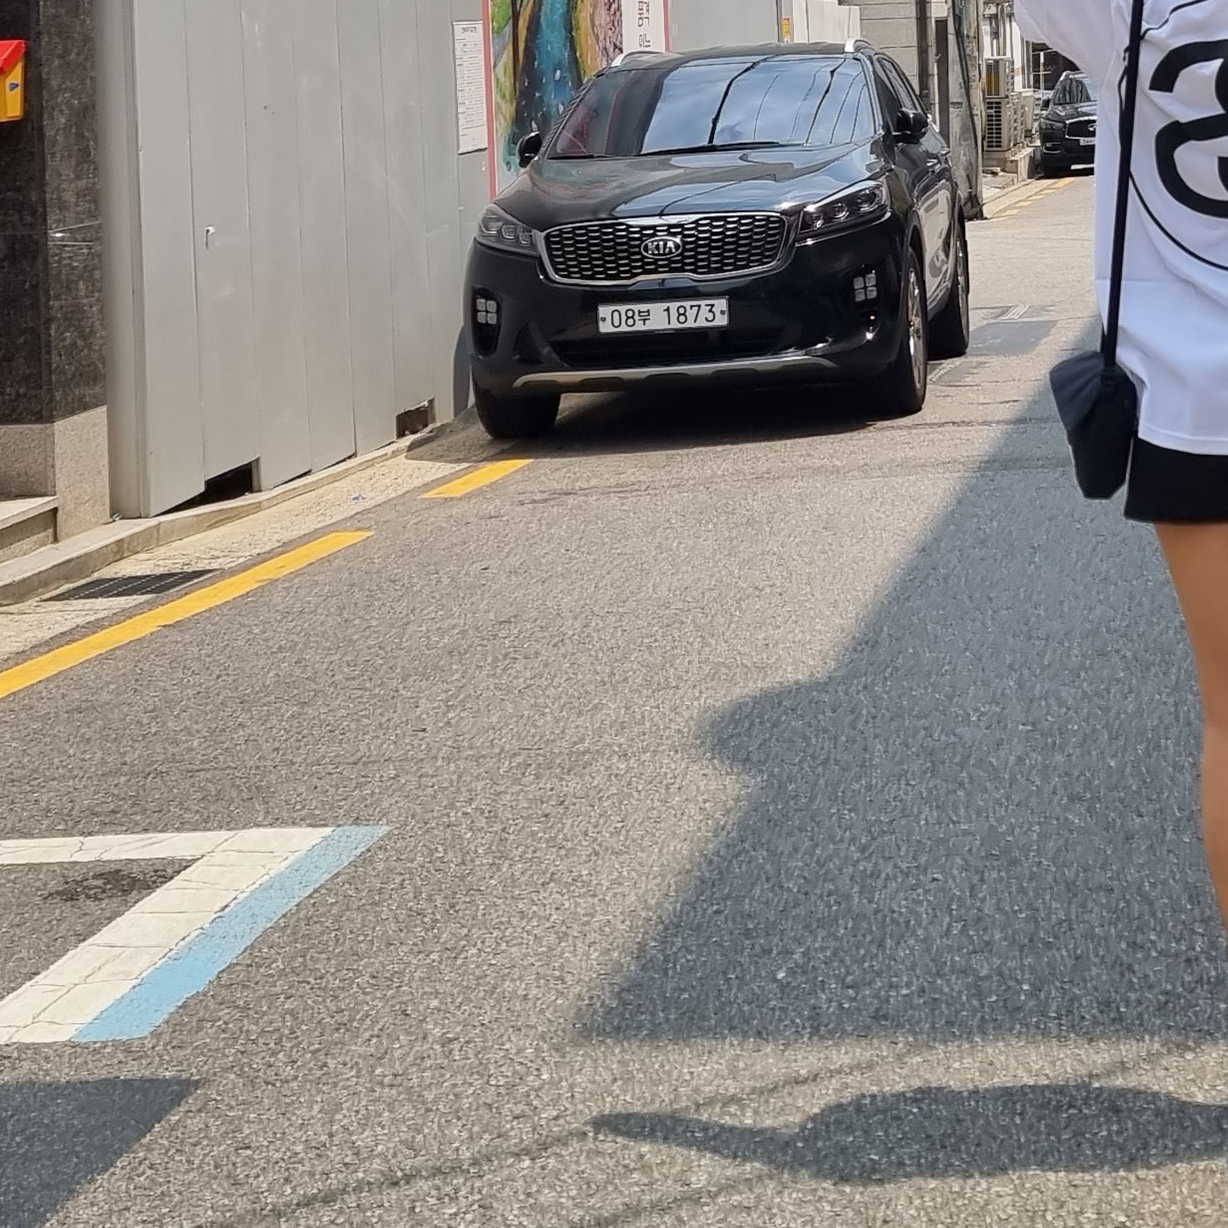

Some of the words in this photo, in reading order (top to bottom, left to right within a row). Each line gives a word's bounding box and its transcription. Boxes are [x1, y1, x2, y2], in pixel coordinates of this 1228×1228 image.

[647, 240, 676, 255] KIA
[610, 308, 651, 329] 08부
[663, 303, 716, 326] 1873
